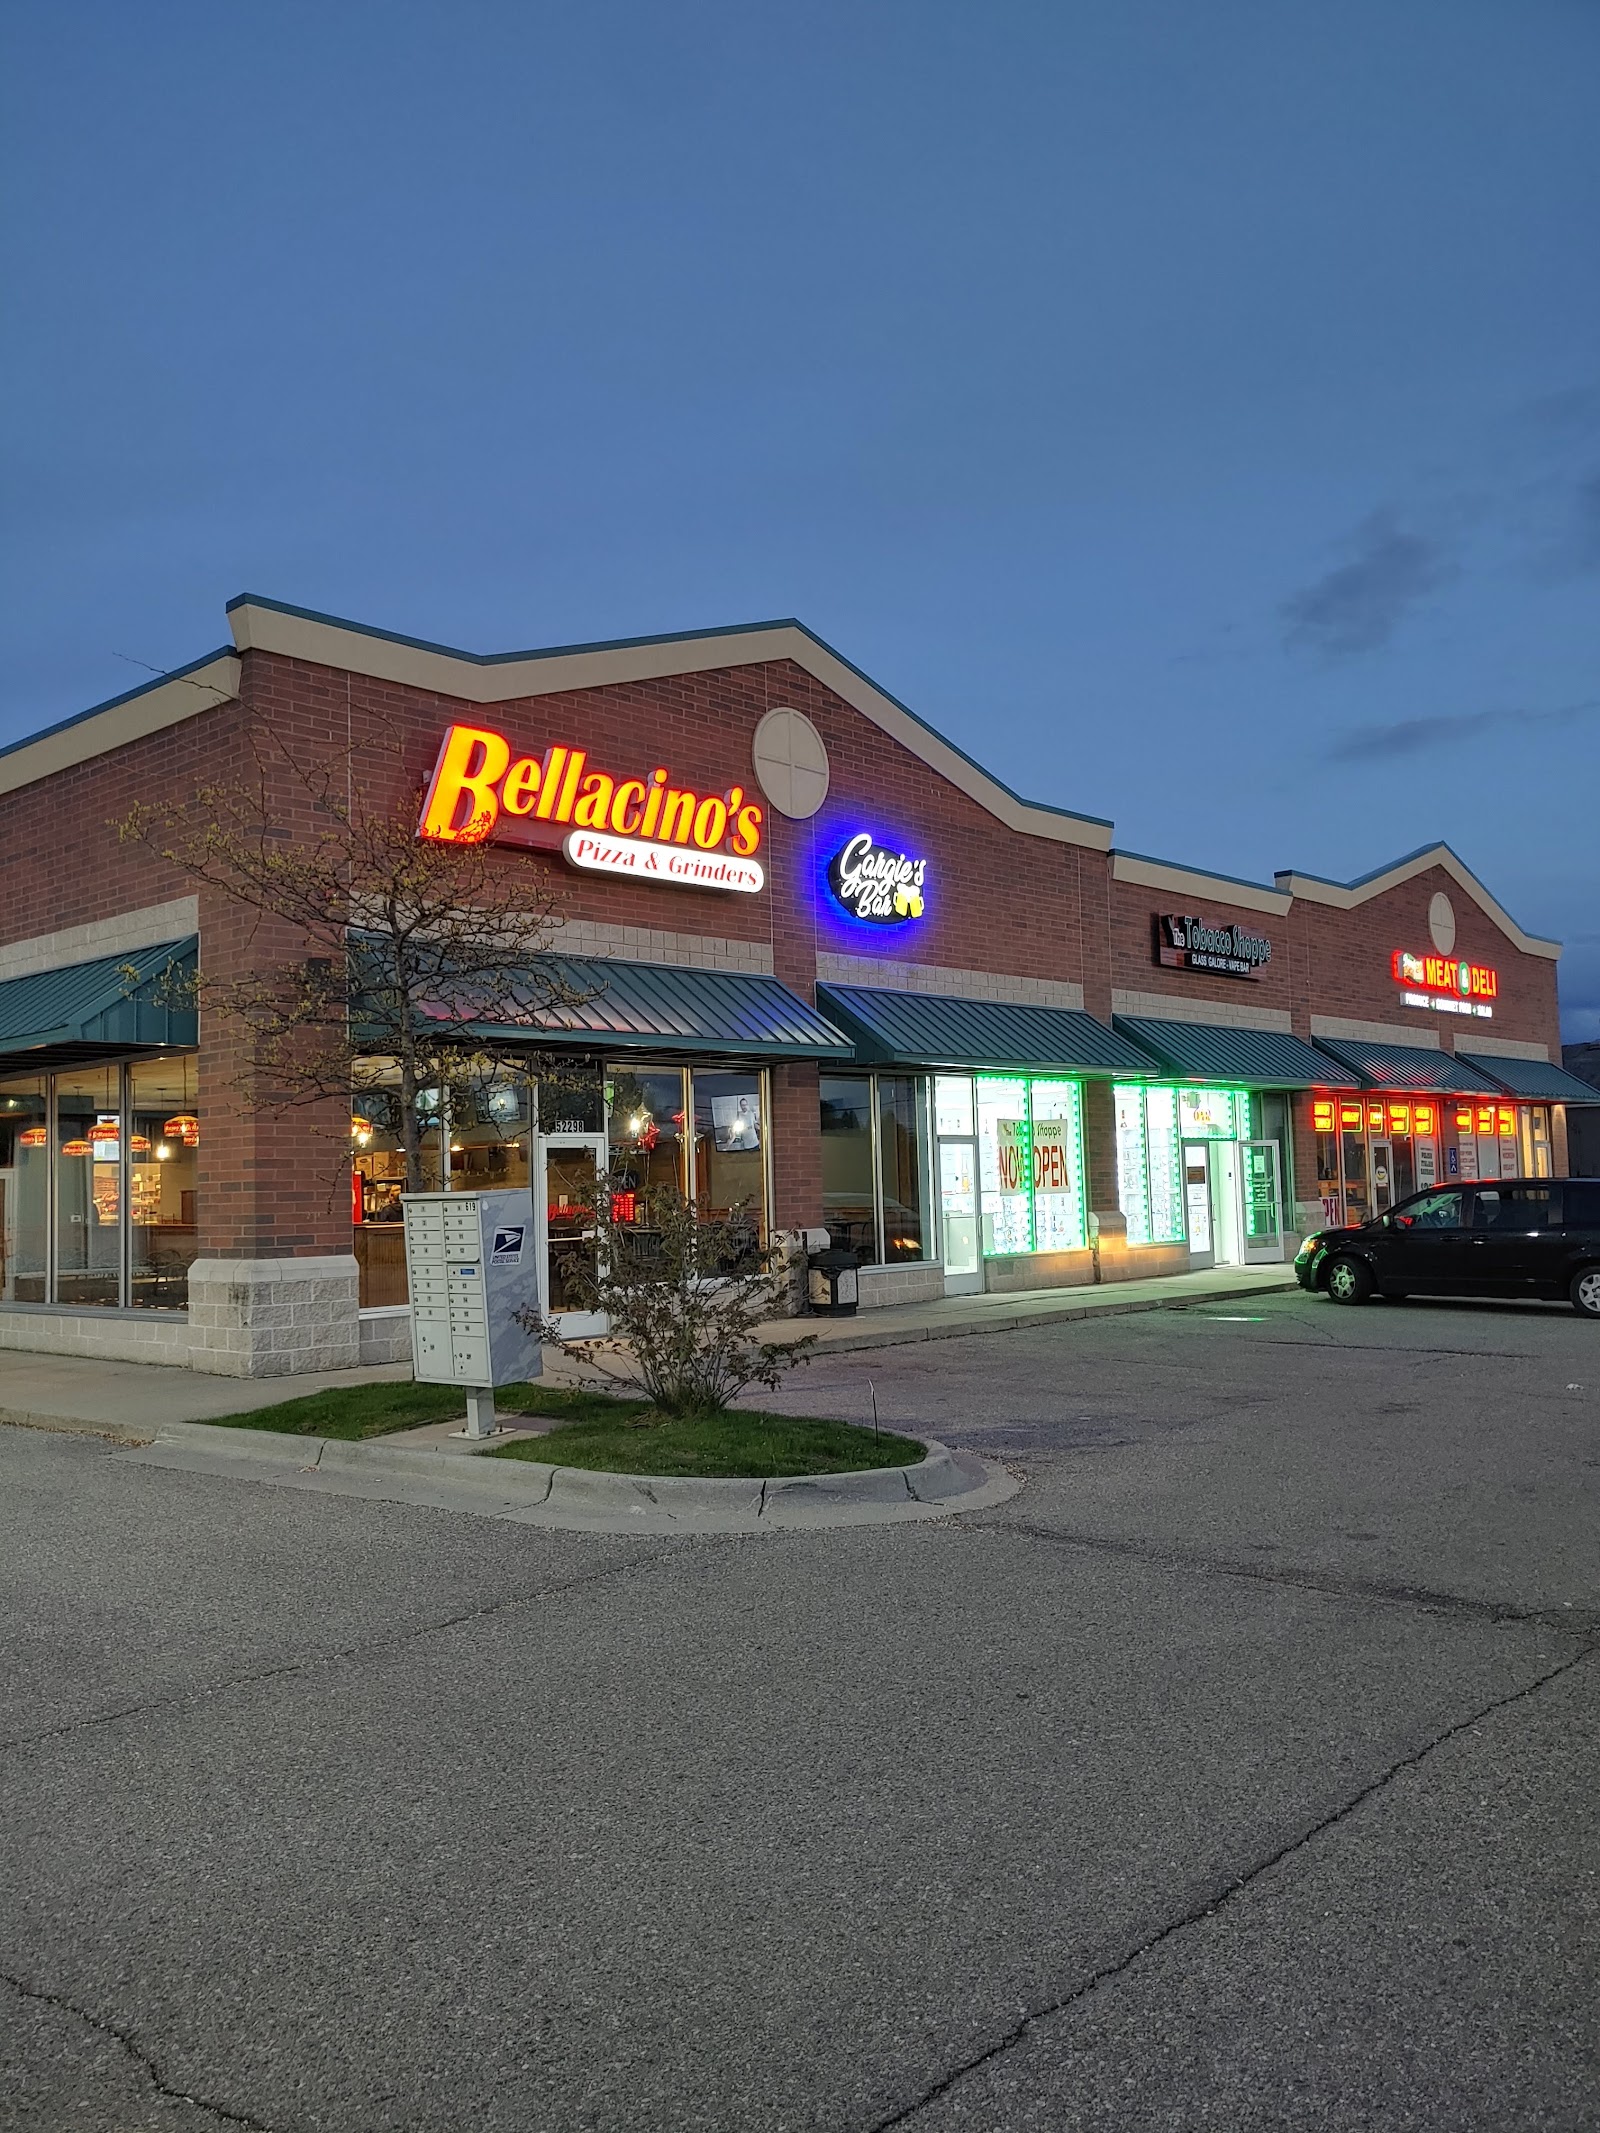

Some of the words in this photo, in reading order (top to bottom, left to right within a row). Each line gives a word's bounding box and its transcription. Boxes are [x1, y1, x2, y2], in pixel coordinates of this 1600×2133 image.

[420, 724, 763, 856] Bellacino's
[576, 839, 636, 867] Pizza
[644, 851, 661, 871] &
[669, 855, 757, 886] Grinders
[855, 880, 893, 918] Bar
[1173, 928, 1185, 947] The
[1185, 916, 1232, 956] Tobacco
[1233, 925, 1271, 967] Shoppe
[1192, 953, 1208, 966] GLASS
[1425, 957, 1457, 989] MEAT
[1472, 966, 1496, 997] DELI
[555, 1120, 584, 1133] 52298
[1037, 1123, 1062, 1139] Shoppe
[1032, 1145, 1069, 1189] OPEN
[465, 1202, 476, 1212] 619
[1322, 1198, 1340, 1226] PEN
